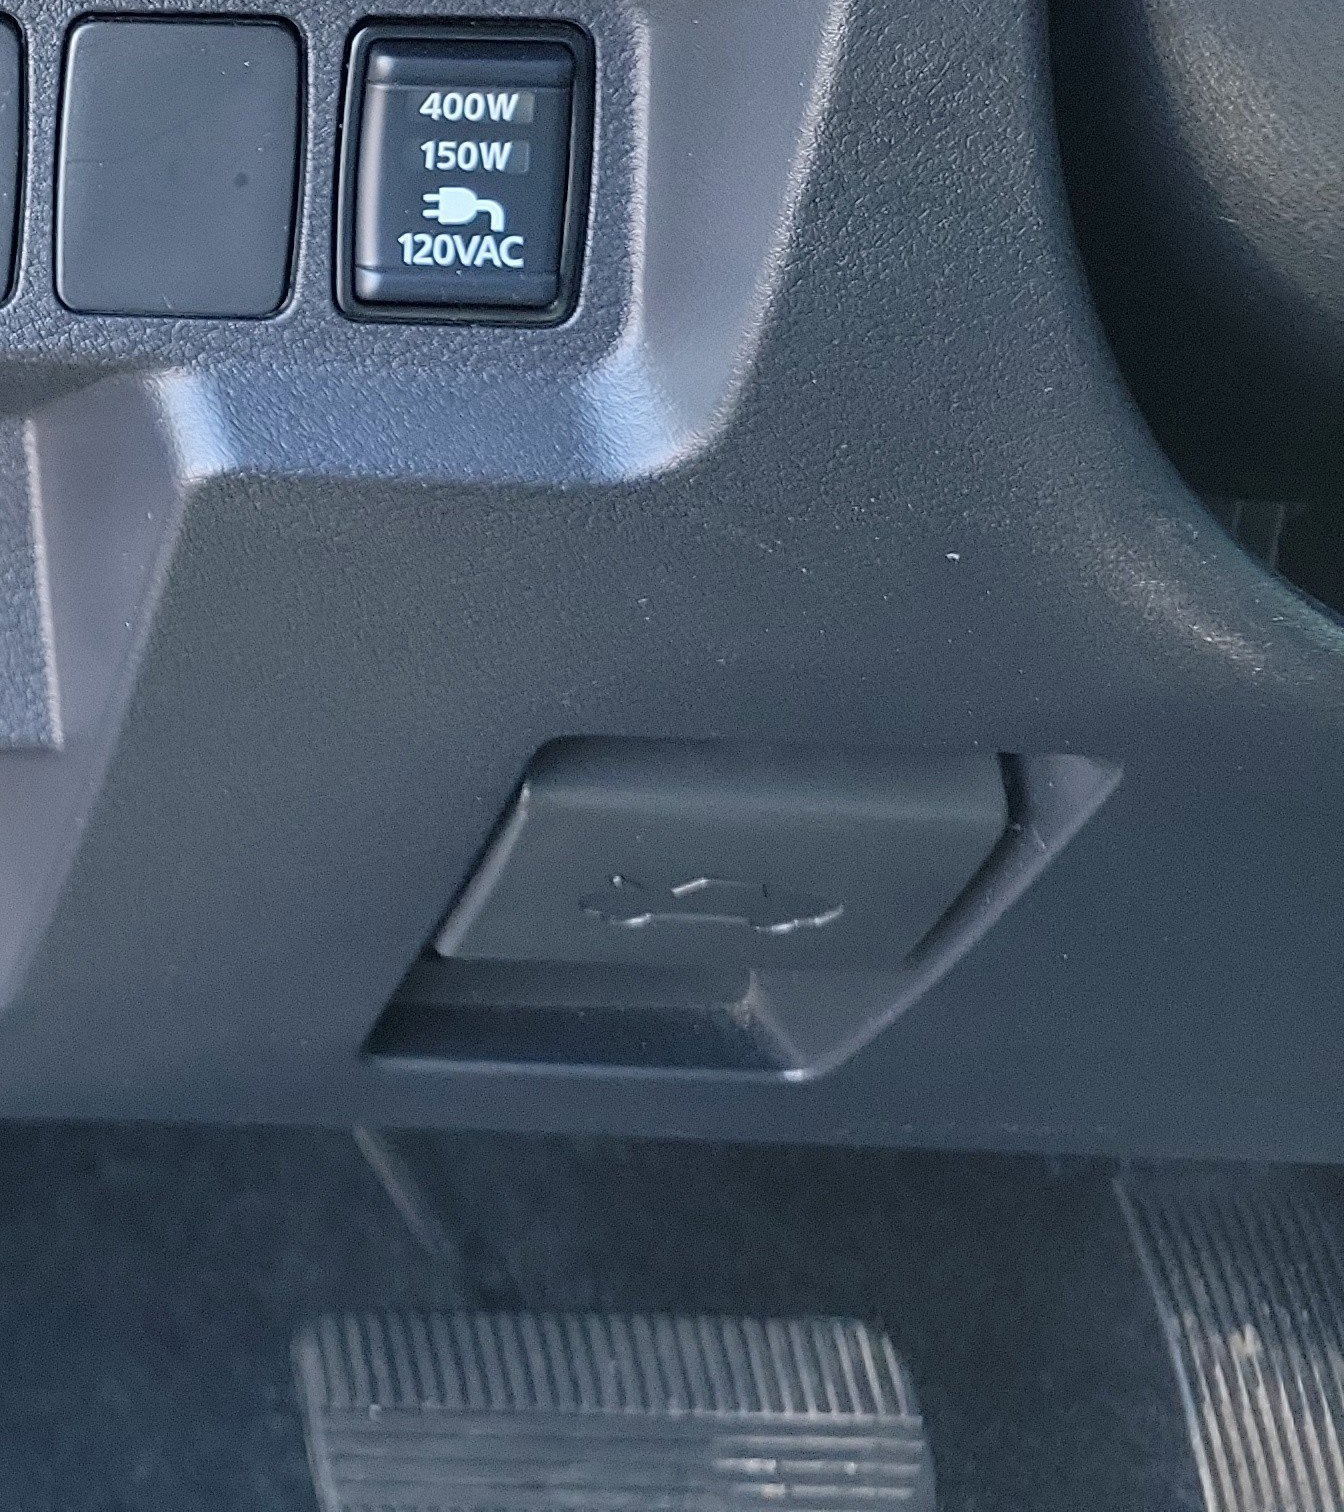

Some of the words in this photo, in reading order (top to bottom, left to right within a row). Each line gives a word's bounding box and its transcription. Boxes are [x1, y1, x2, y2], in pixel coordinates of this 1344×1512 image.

[418, 92, 519, 122] 400W
[419, 140, 513, 172] 150W
[397, 233, 525, 268] 120VAC
